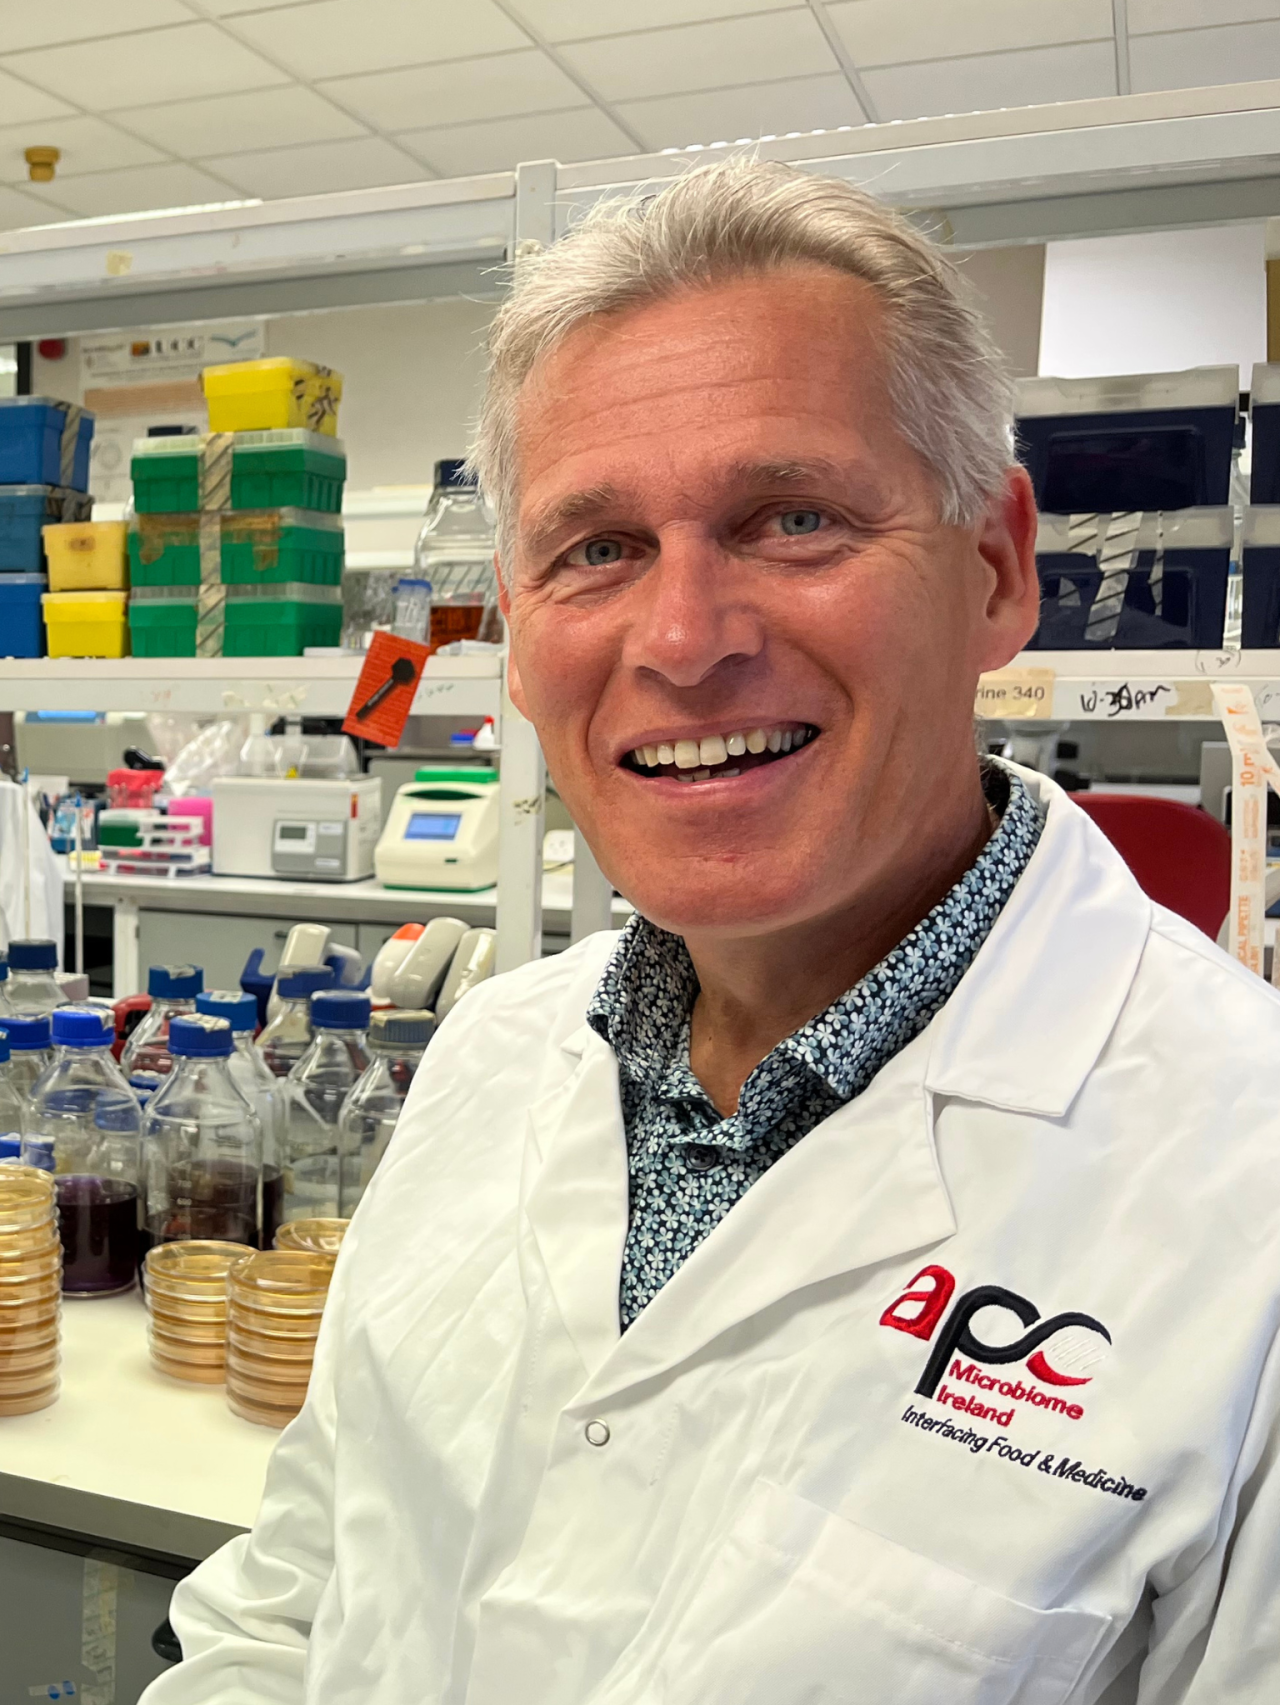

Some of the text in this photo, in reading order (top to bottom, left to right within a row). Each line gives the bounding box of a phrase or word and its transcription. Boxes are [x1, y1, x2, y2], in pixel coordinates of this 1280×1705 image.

[1012, 685, 1045, 701] 340
[1239, 769, 1255, 787] 10
[1237, 895, 1250, 937] PIPETTE
[936, 1385, 1015, 1428] Ireland
[948, 1359, 1084, 1420] Microbiome
[901, 1405, 1148, 1501] Interfacing Food & Medicine
